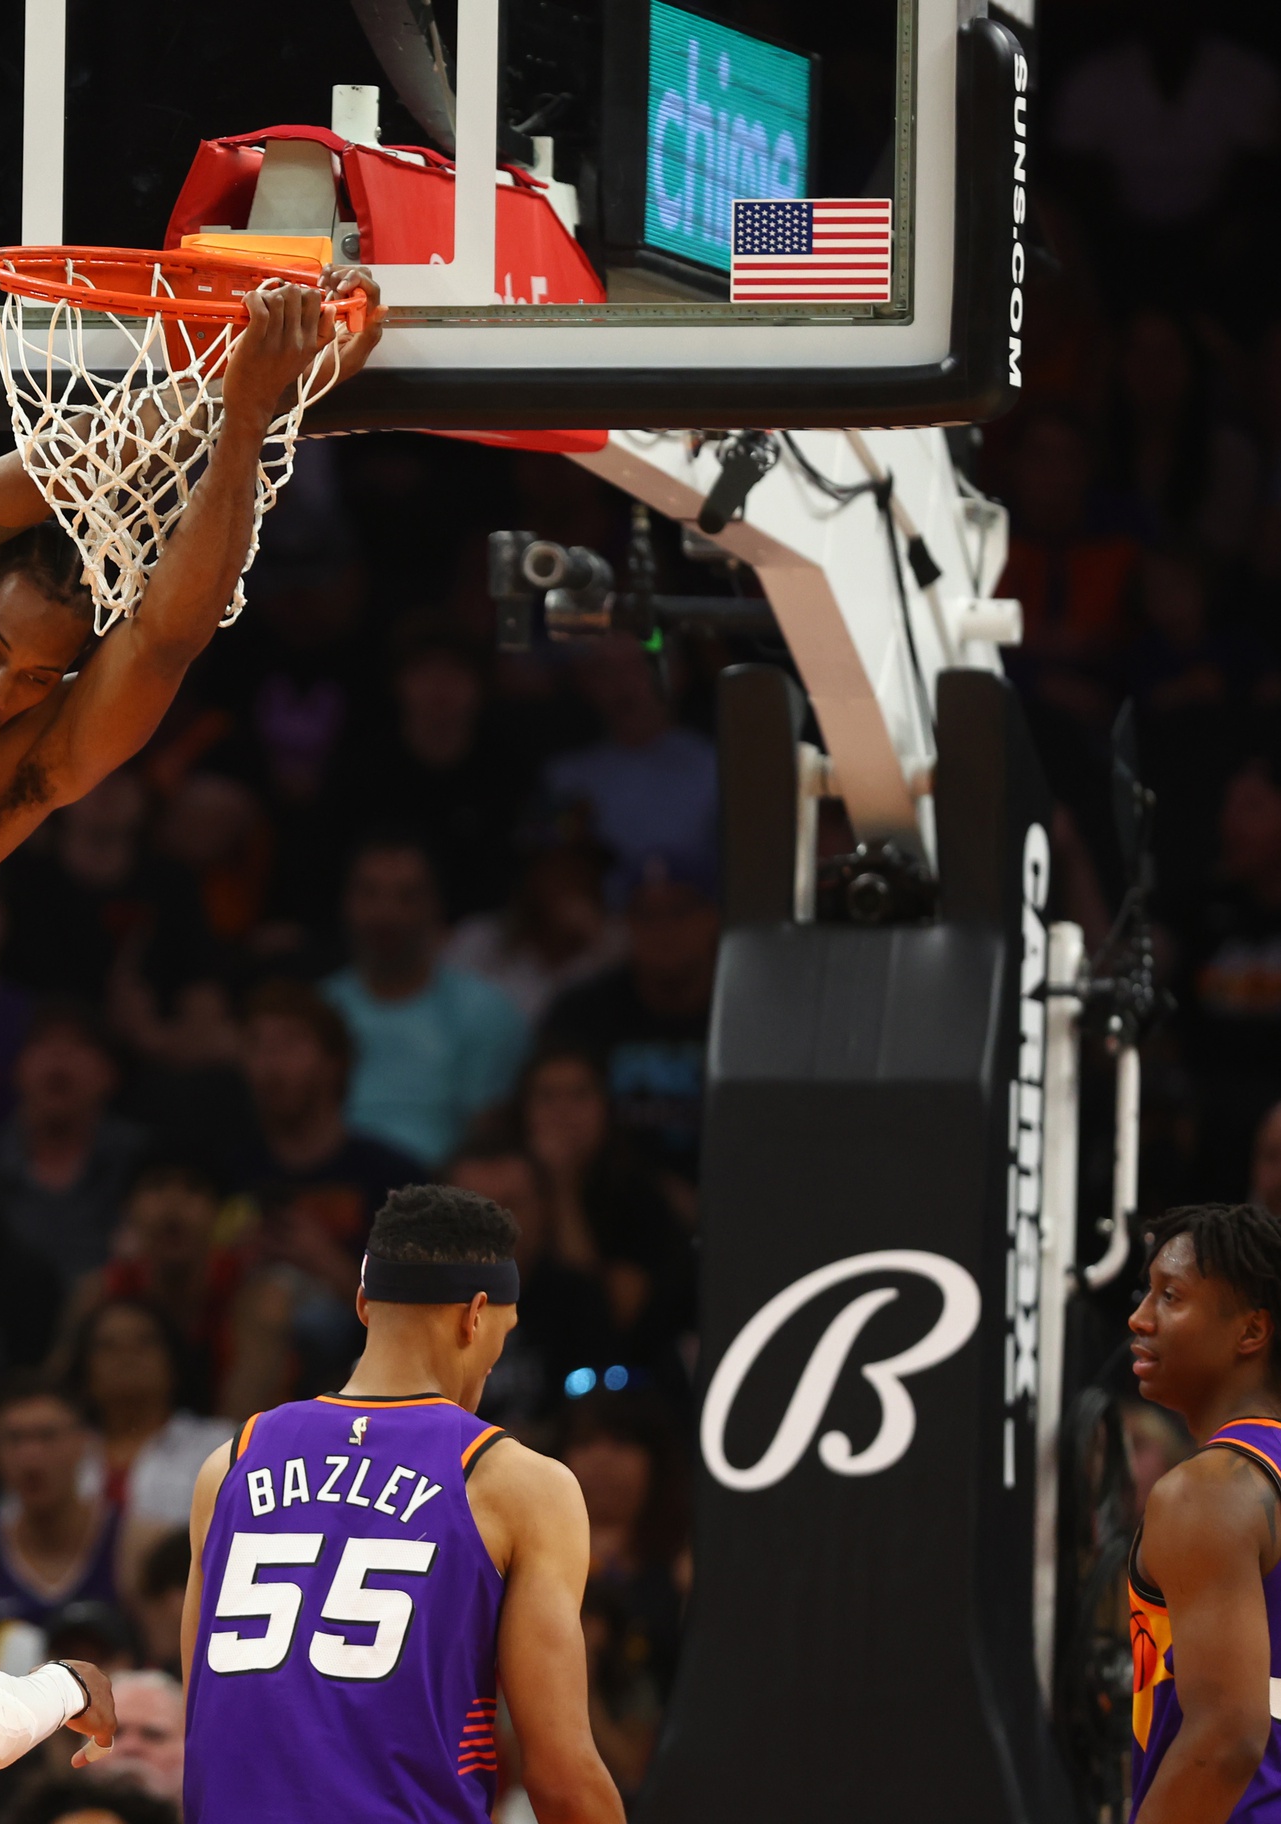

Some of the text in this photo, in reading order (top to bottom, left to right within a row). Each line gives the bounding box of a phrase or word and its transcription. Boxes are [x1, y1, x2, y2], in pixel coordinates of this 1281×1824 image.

[1008, 53, 1029, 388] SUNS.COM
[700, 1248, 982, 1492] B
[246, 1454, 444, 1525] BAZLEY
[206, 1532, 440, 1683] 55
